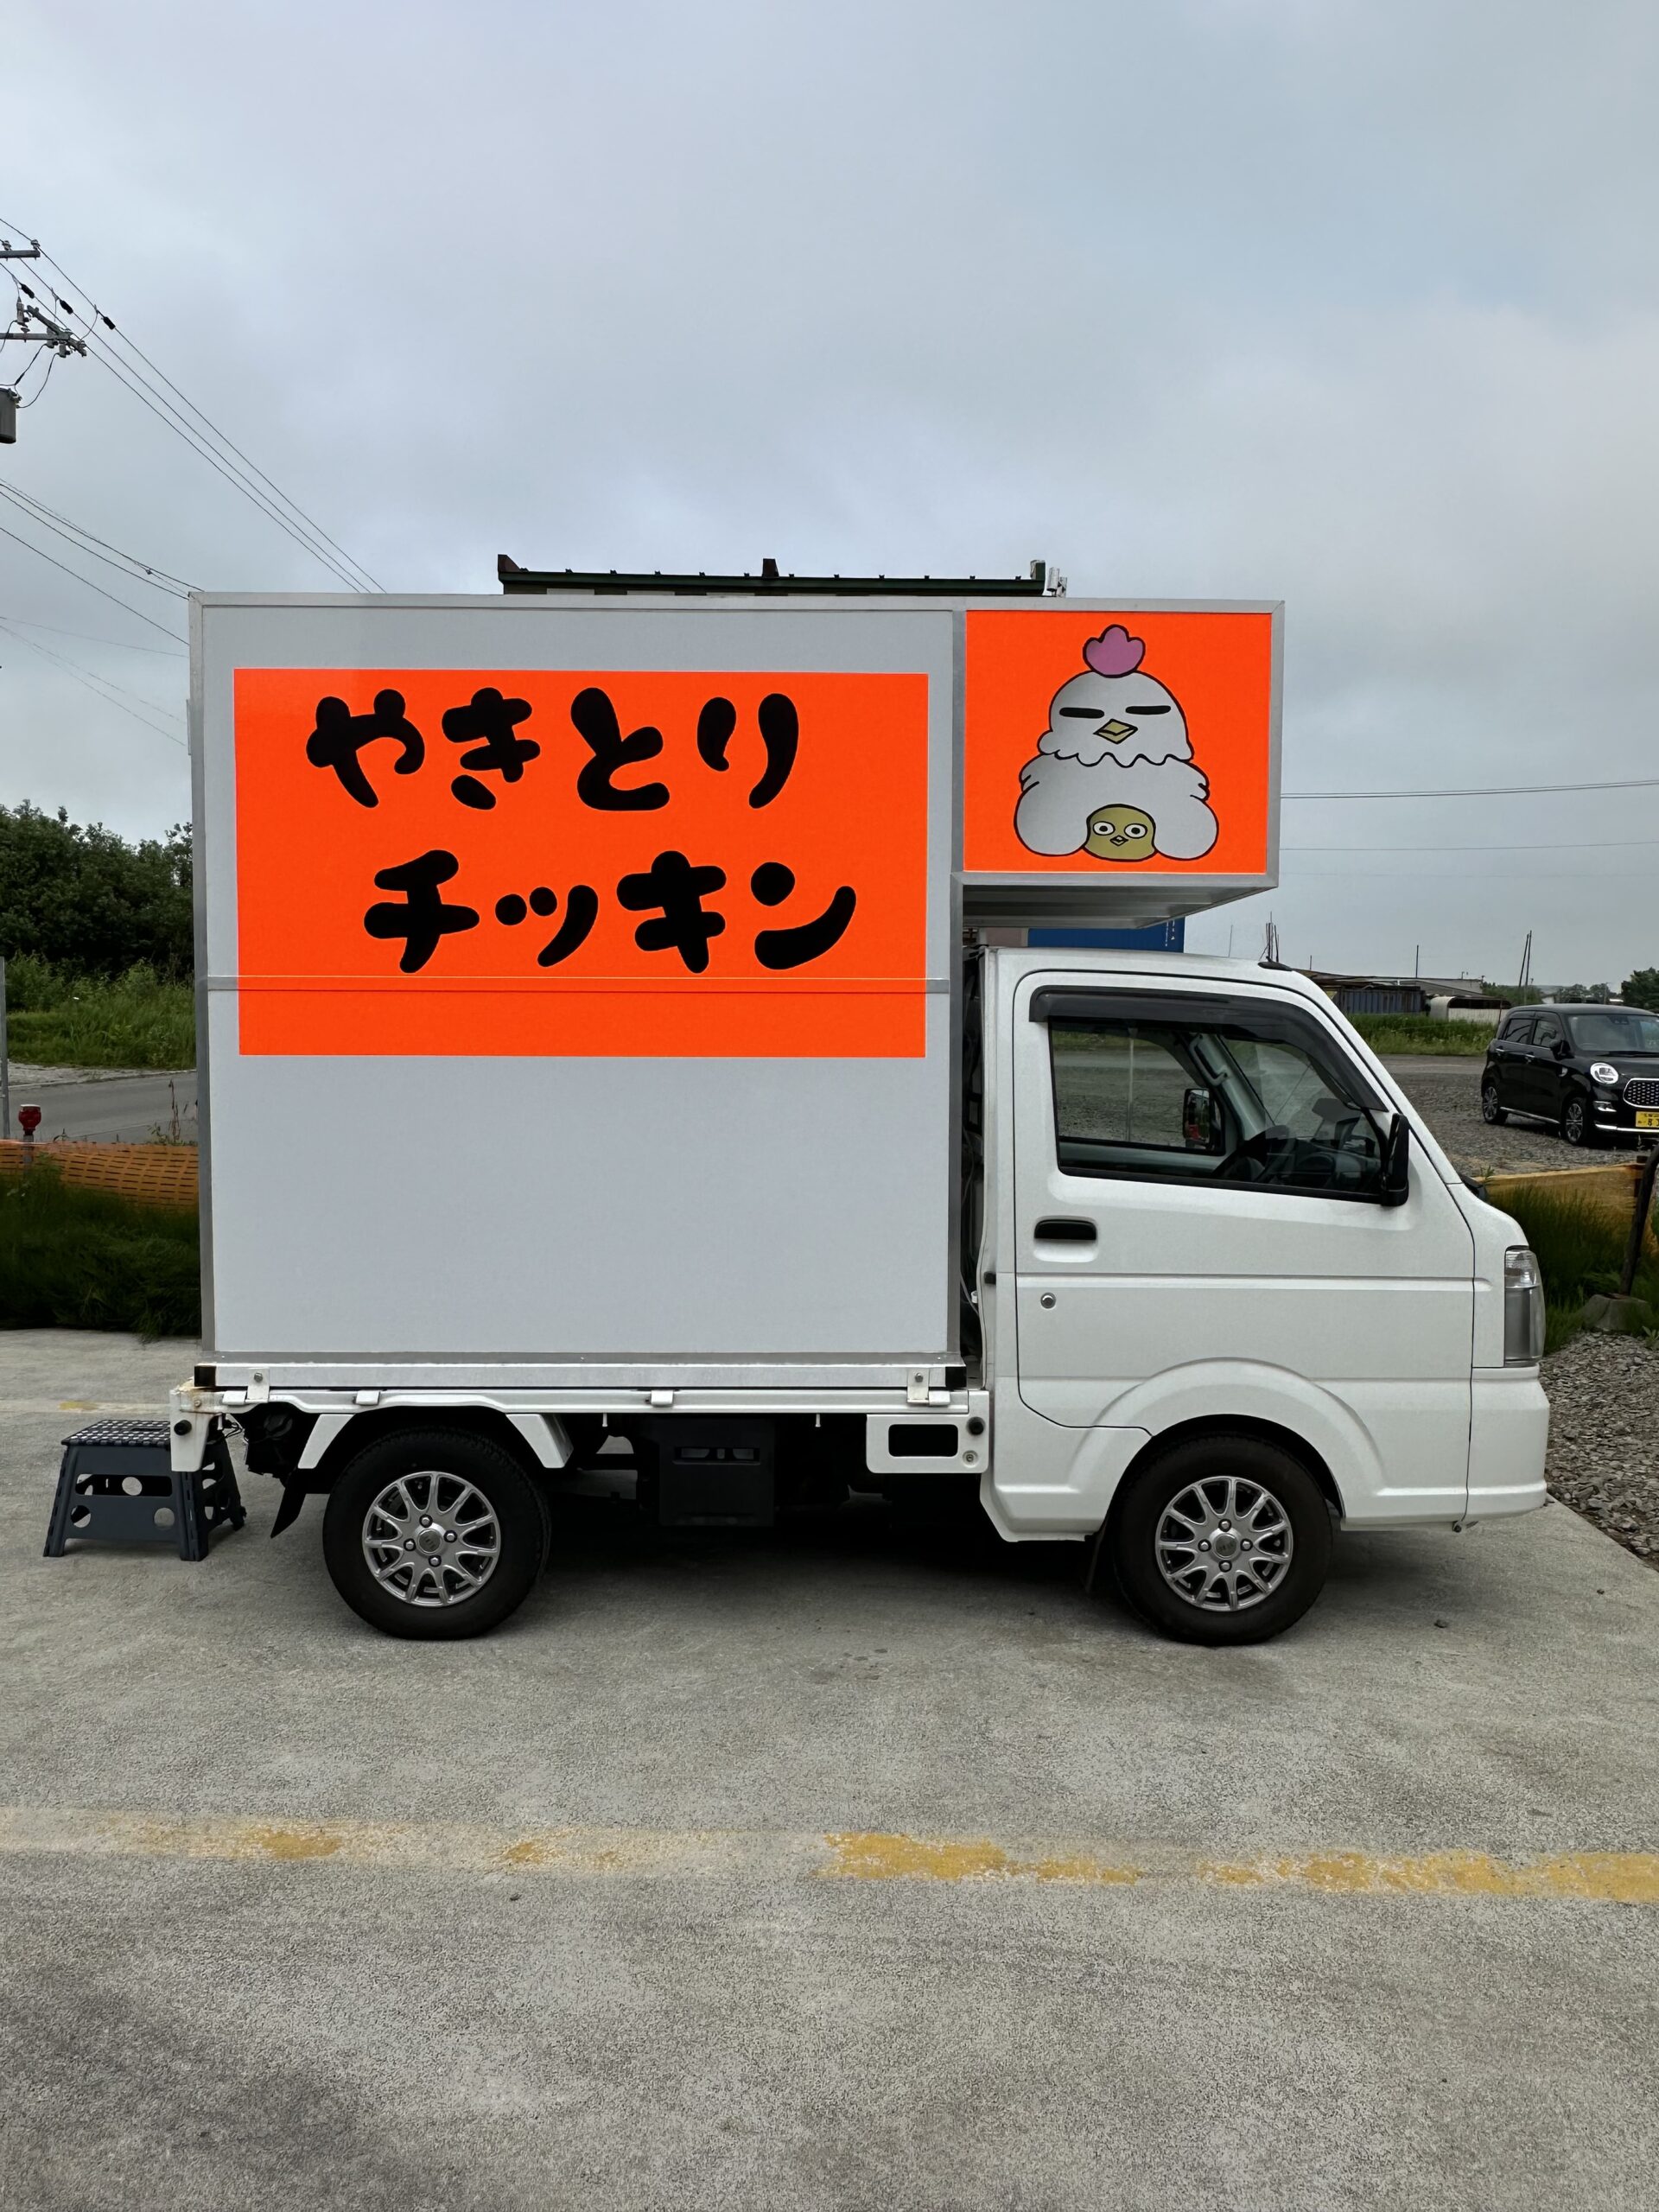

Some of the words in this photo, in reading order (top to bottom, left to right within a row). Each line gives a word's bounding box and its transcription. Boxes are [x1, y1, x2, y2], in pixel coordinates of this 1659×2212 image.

[307, 688, 798, 810] やきとり
[365, 850, 855, 973] チッキン
